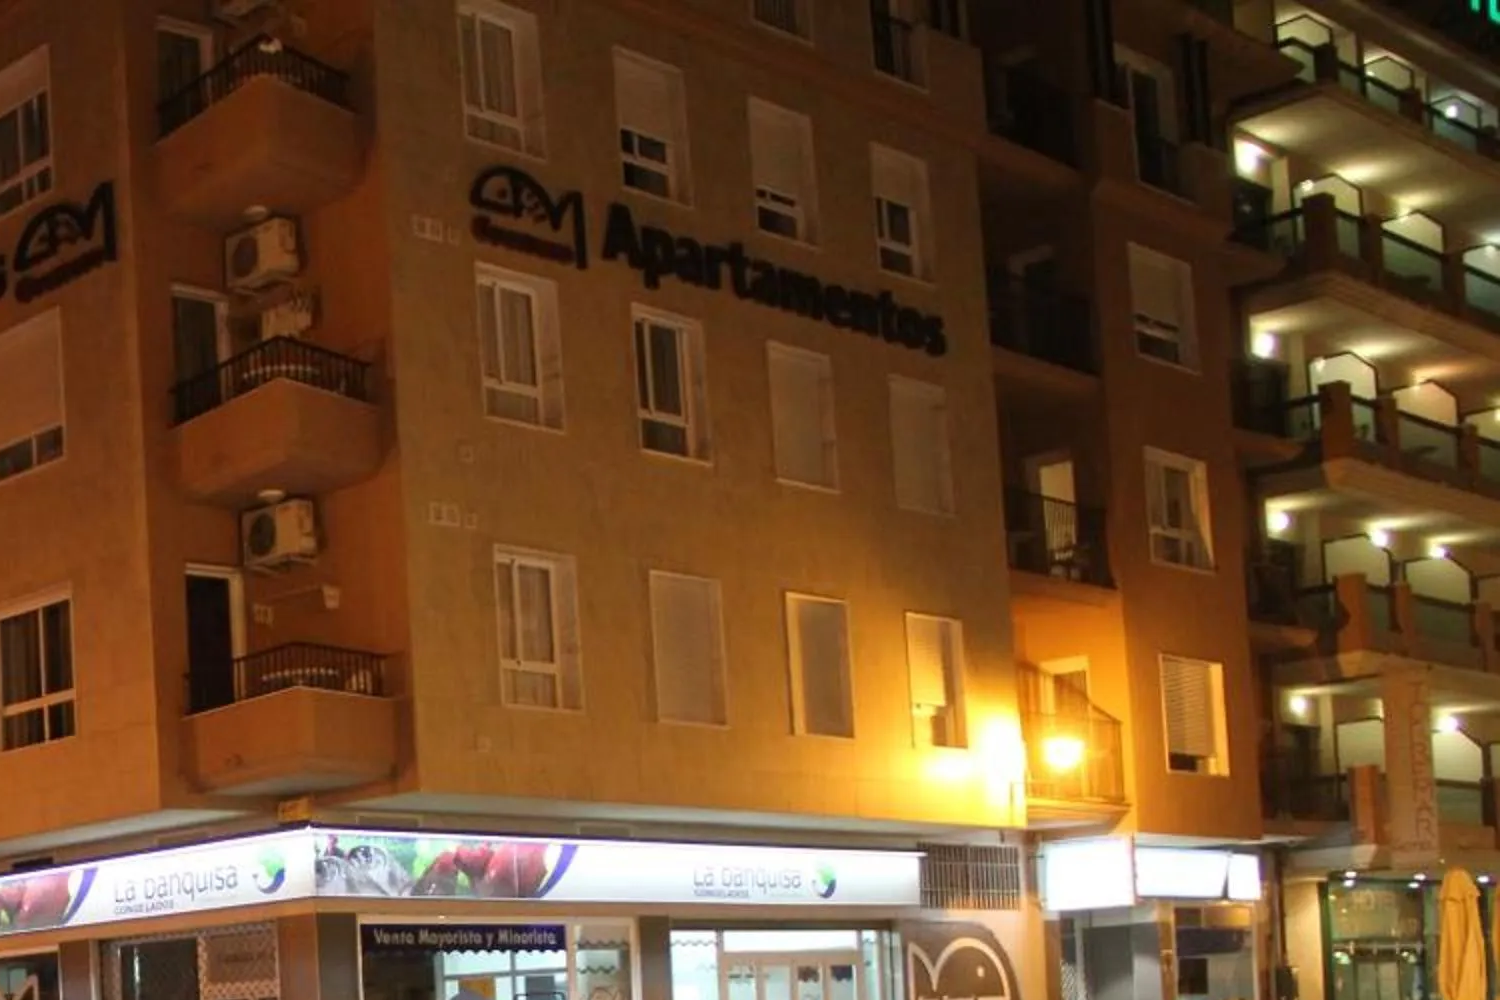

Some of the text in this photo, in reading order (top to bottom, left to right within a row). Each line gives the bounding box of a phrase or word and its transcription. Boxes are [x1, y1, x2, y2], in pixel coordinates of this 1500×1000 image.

[601, 203, 947, 356] Apartamentos
[114, 864, 239, 903] La banquisa
[693, 865, 714, 886] La
[373, 927, 557, 948] Venta Mayorista y Minorista
